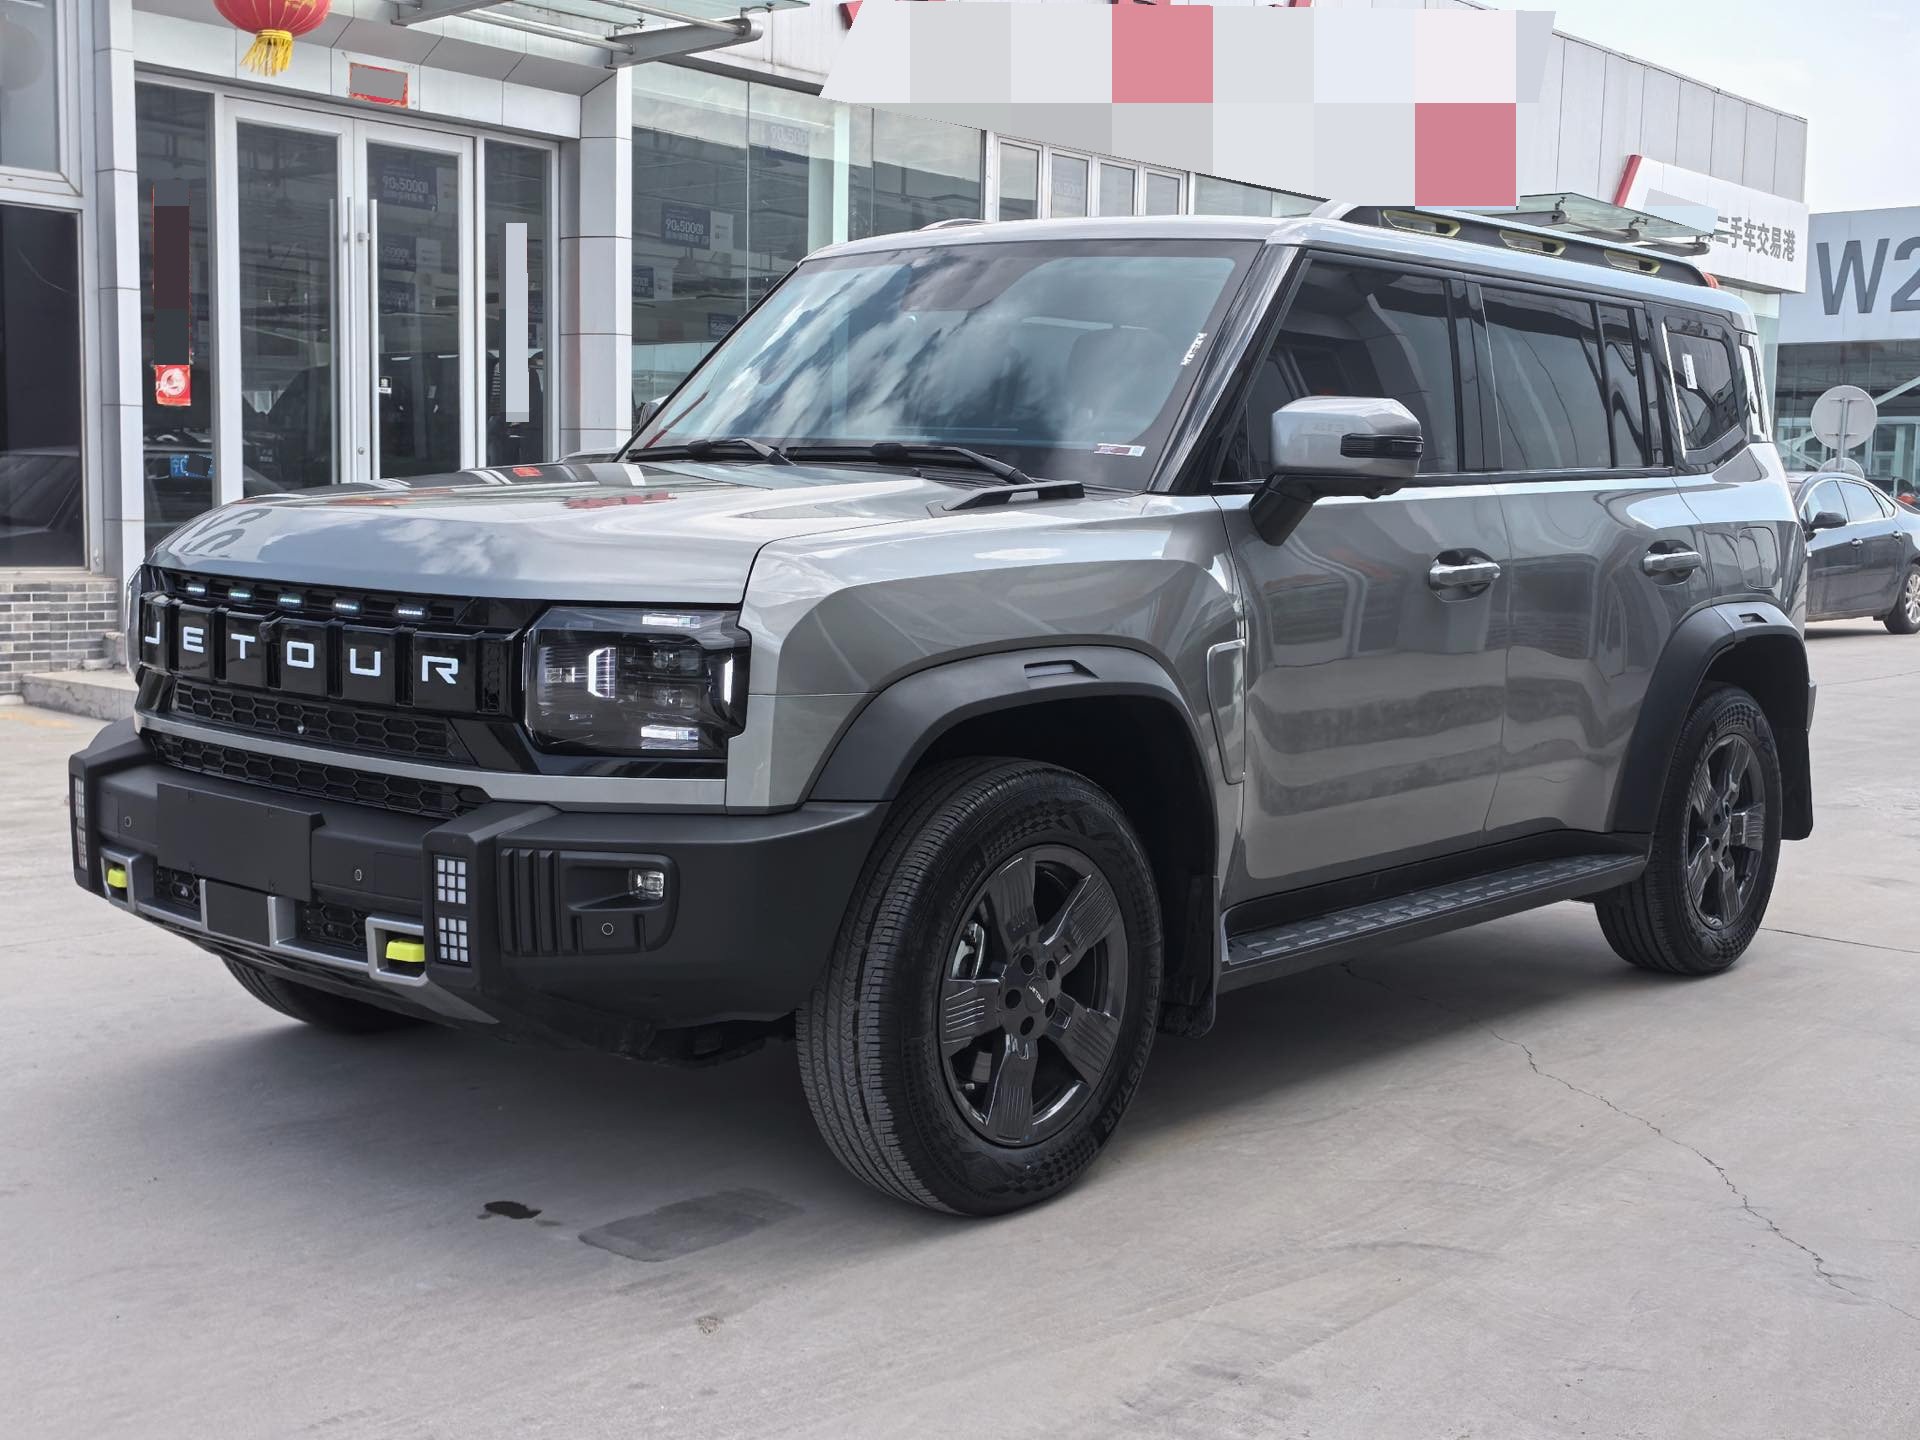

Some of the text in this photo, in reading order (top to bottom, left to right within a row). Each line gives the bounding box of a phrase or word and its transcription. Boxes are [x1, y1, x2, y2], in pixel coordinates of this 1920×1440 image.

[1702, 216, 1795, 262] 二手车交易港
[1816, 236, 1920, 315] W2
[144, 621, 459, 684] JETOUR
